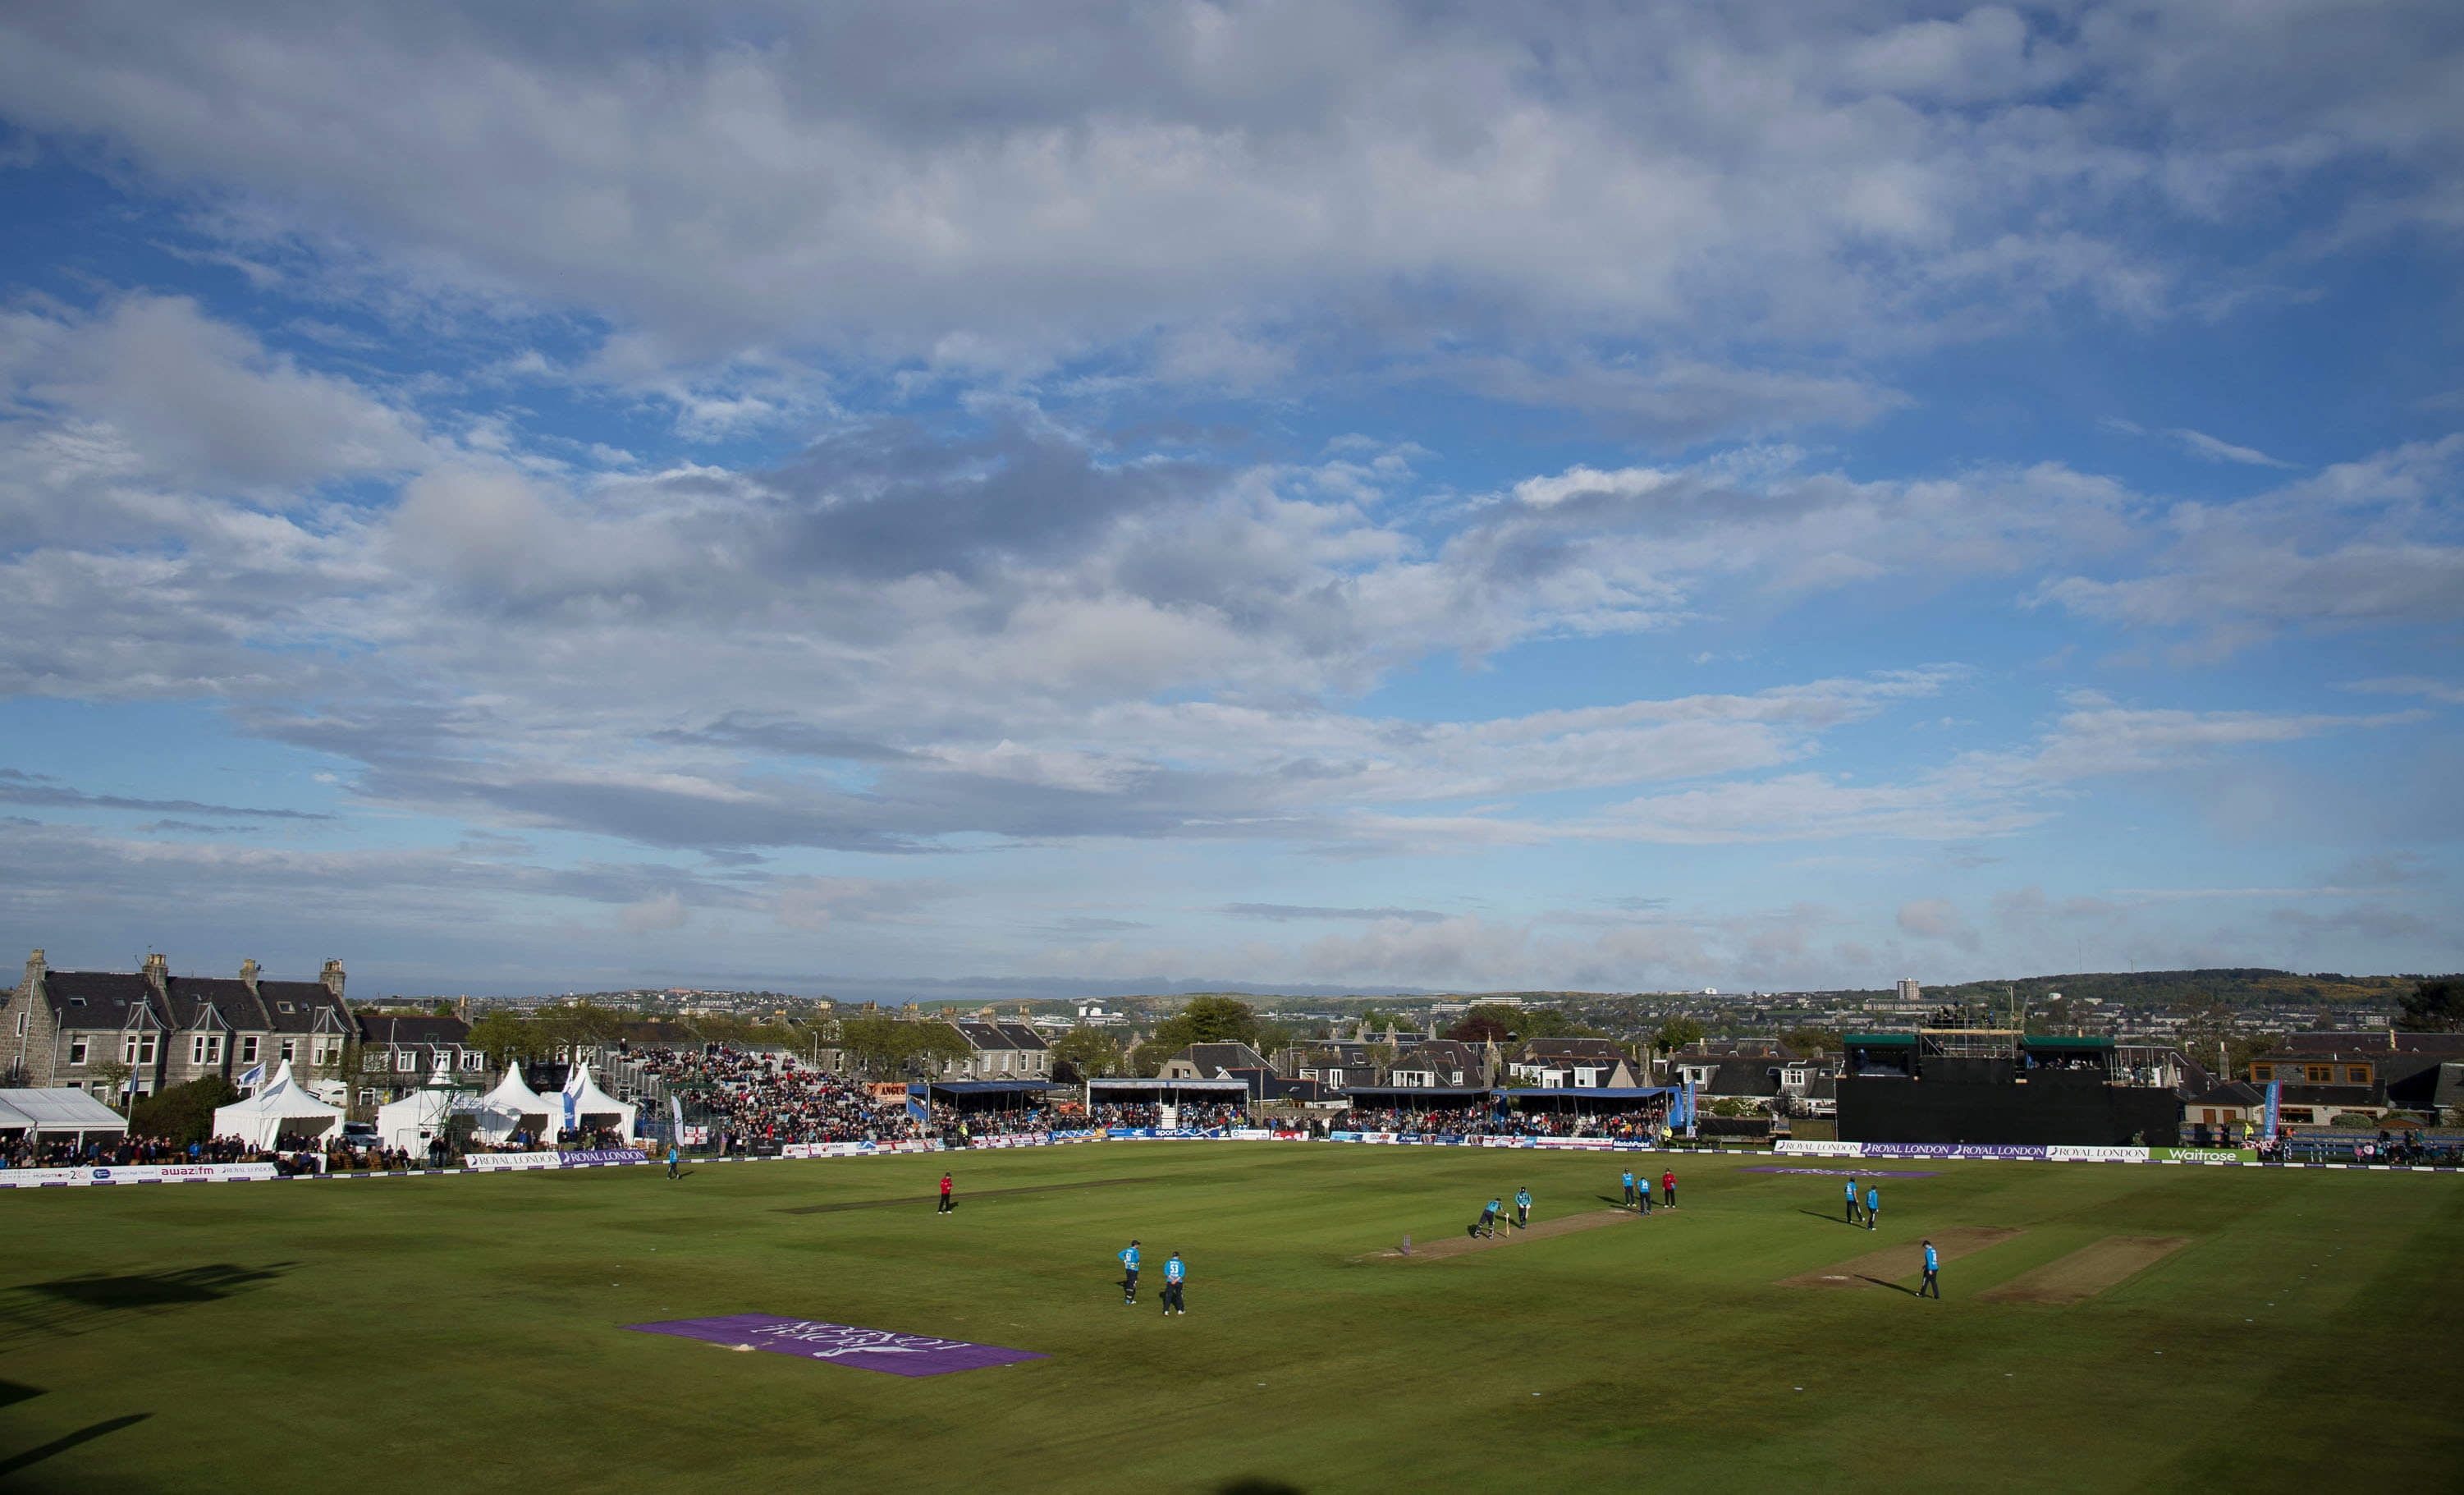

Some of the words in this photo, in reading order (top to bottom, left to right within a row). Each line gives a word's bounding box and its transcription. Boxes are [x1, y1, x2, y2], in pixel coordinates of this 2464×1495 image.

[882, 1085, 906, 1095] ANGUS
[1785, 1142, 1812, 1150] ROYAL
[1816, 1143, 1858, 1151] LONDON
[1871, 1144, 1901, 1153] ROYAL
[1904, 1144, 1949, 1154] LONDON
[1962, 1146, 1995, 1155] ROYAL
[1998, 1147, 2045, 1156] LONDON
[570, 1152, 603, 1162] ROYAL
[602, 1151, 645, 1161] LONDON
[2097, 1149, 2146, 1157] LONDON
[2169, 1149, 2237, 1161] Waitrose
[479, 1155, 512, 1165] ROYAL
[514, 1154, 558, 1164] LONDON
